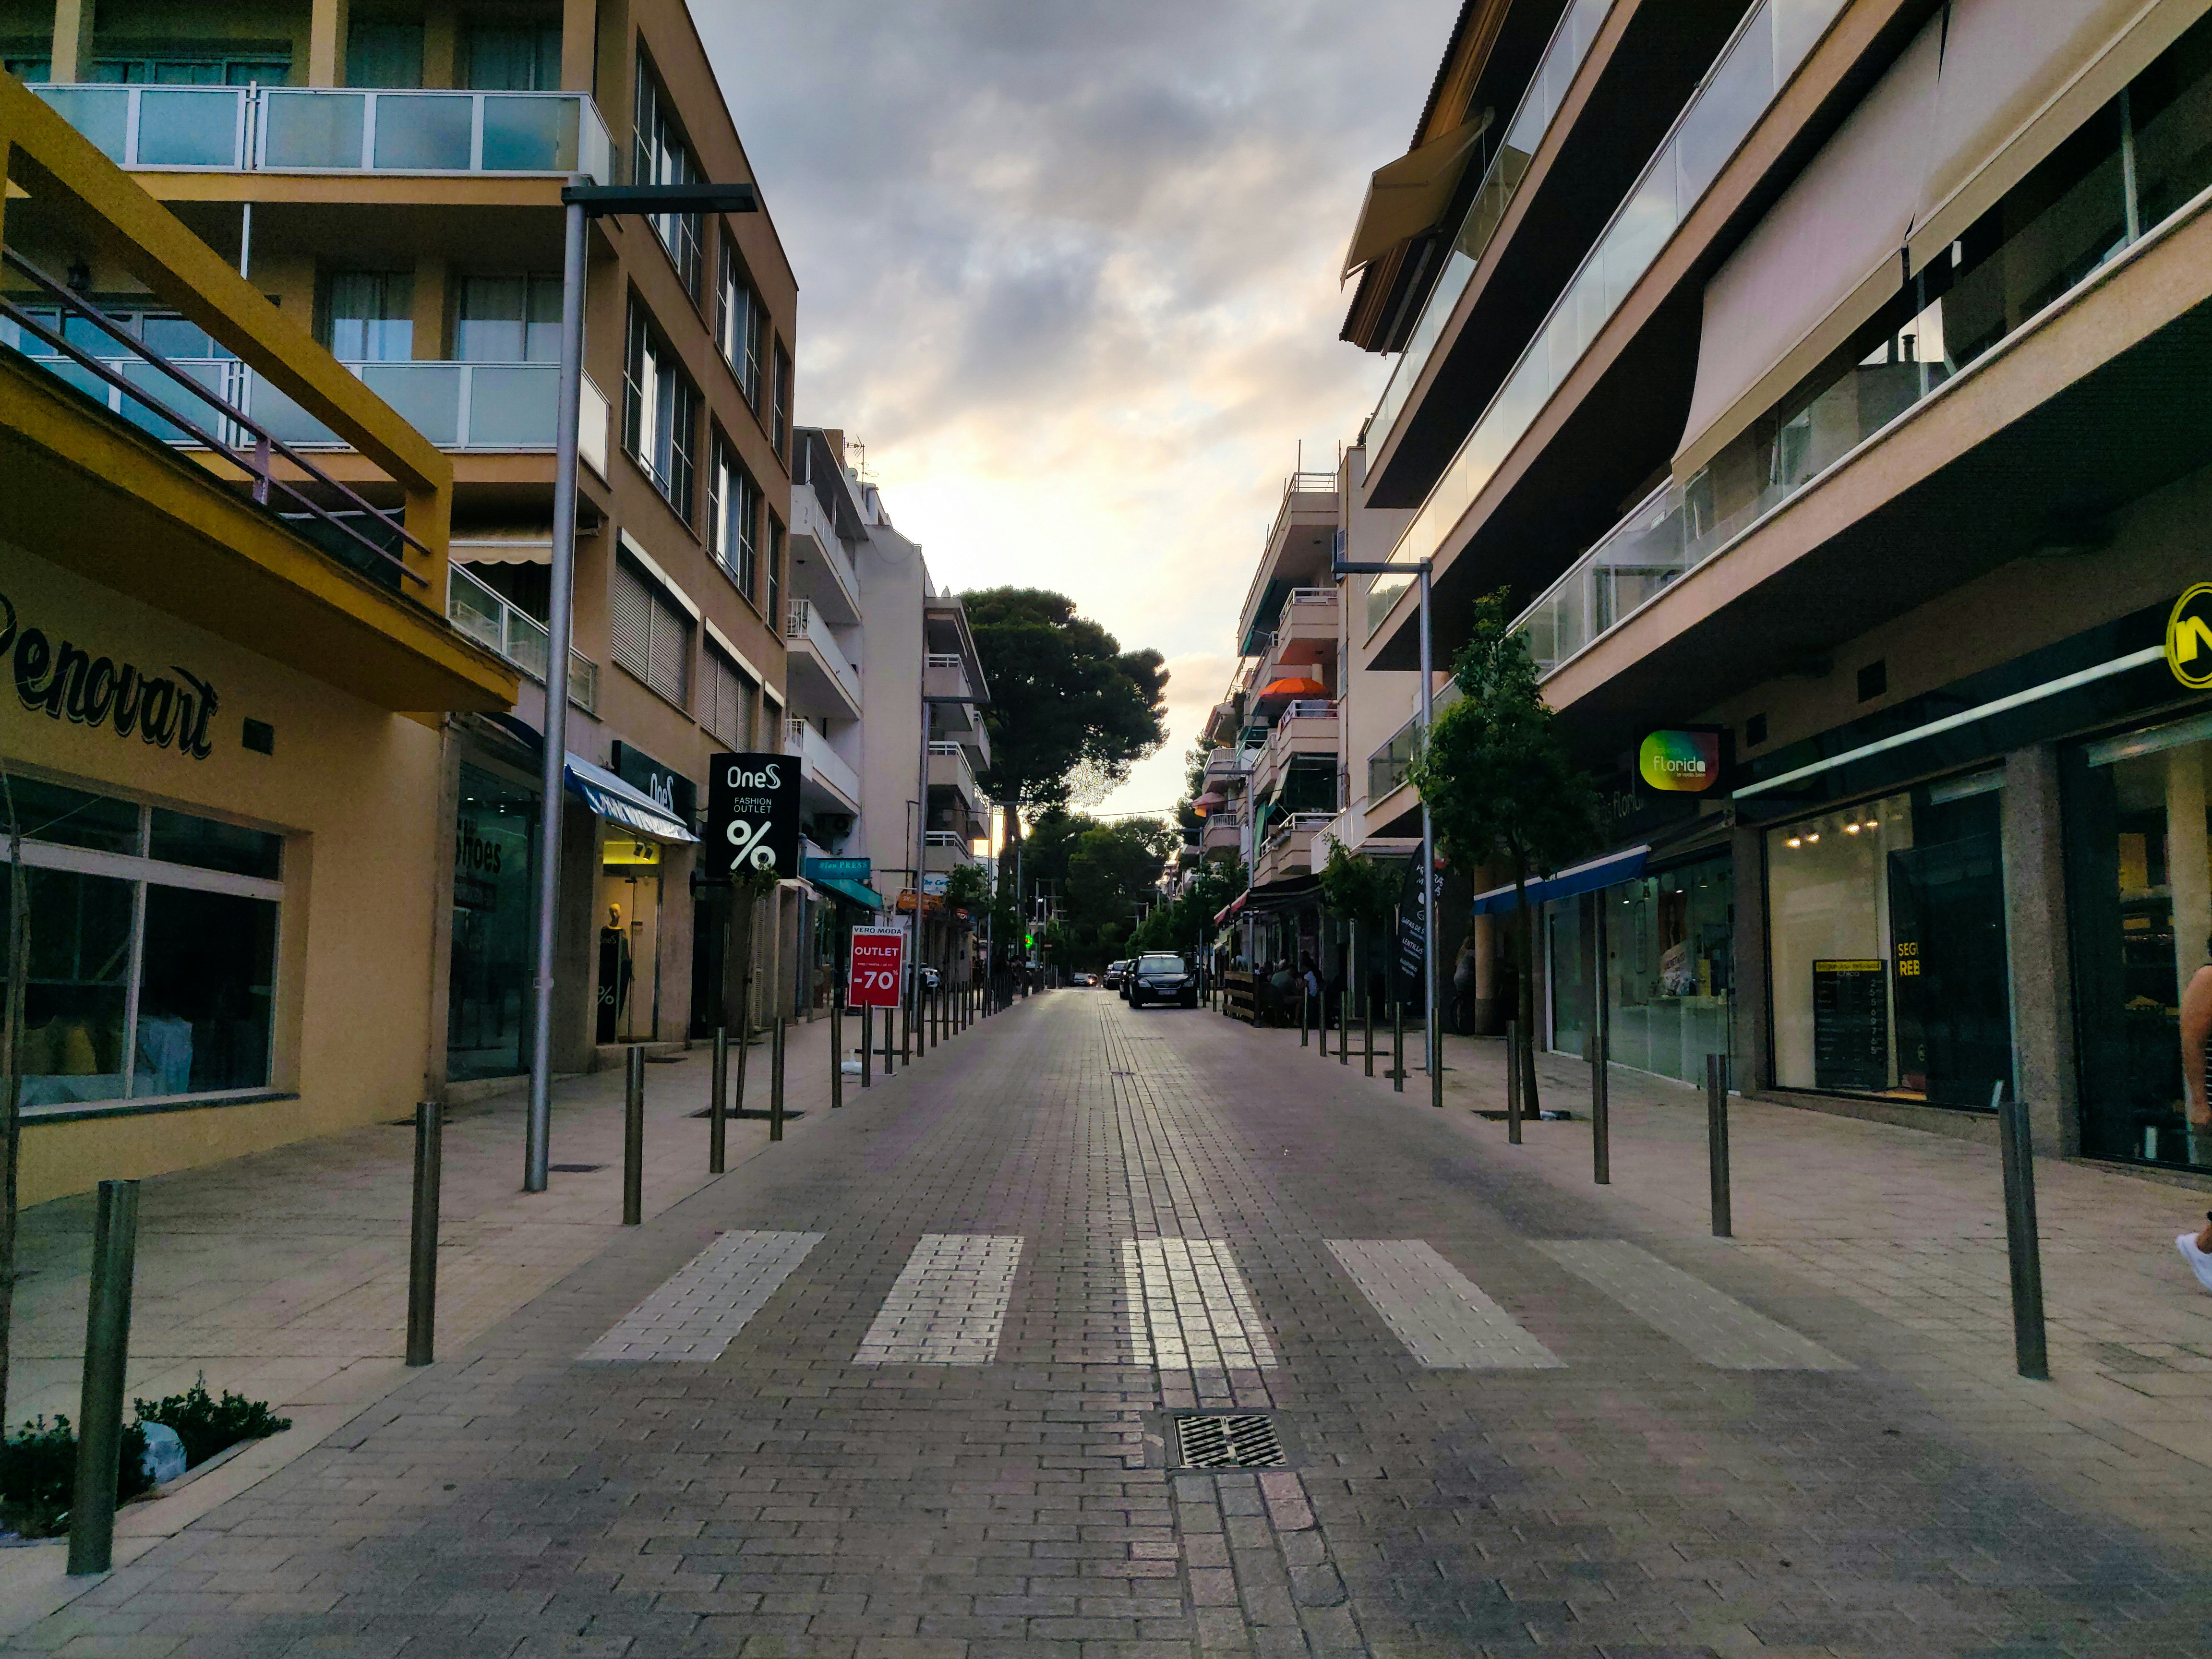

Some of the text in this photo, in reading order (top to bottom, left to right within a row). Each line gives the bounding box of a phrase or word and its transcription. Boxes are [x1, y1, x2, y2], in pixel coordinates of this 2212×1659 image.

[1653, 755, 1706, 772] florida
[727, 763, 781, 790] OneS
[734, 797, 772, 805] FASHION
[733, 805, 772, 814] OUTLET
[854, 946, 899, 957] OUTLET
